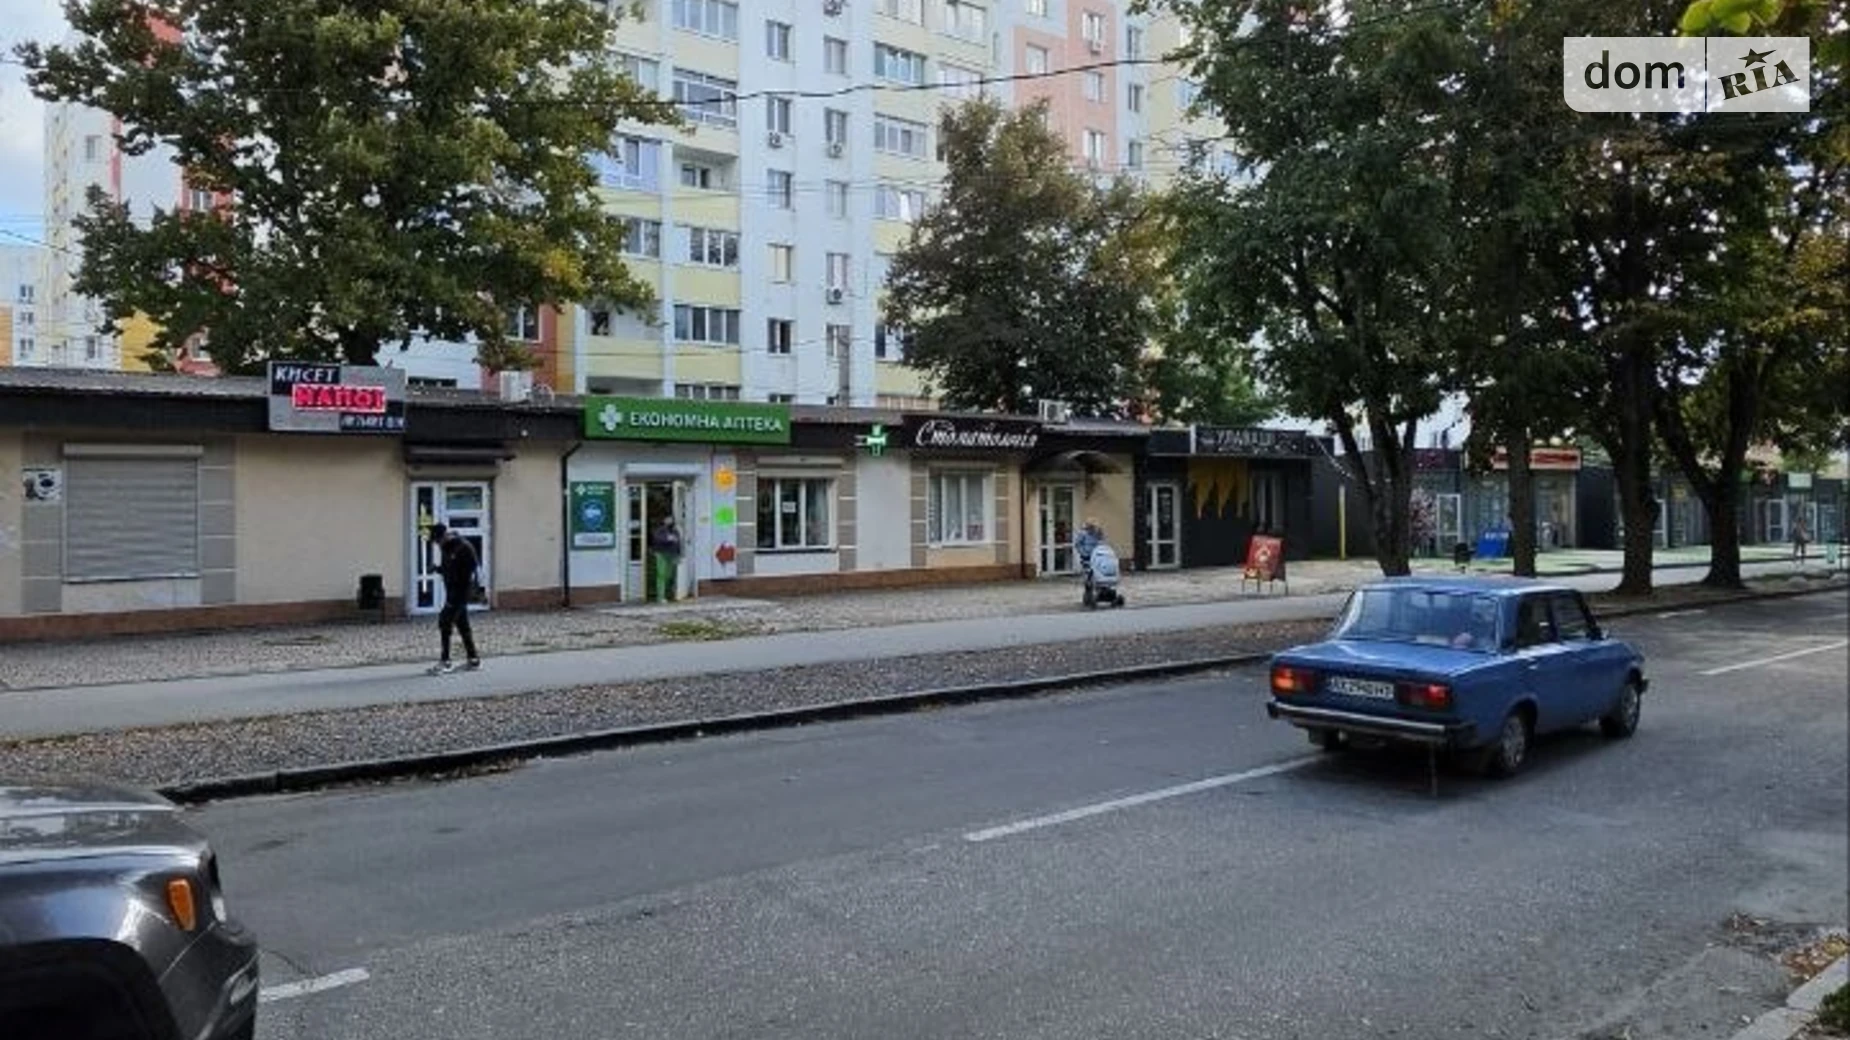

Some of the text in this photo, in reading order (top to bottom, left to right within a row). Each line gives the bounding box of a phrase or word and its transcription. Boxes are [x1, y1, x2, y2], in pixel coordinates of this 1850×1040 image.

[274, 365, 336, 382] КИСЕТ
[630, 411, 783, 432] ЕКОНОМНА АПТЕКА
[915, 419, 1038, 448] Стоматологія
